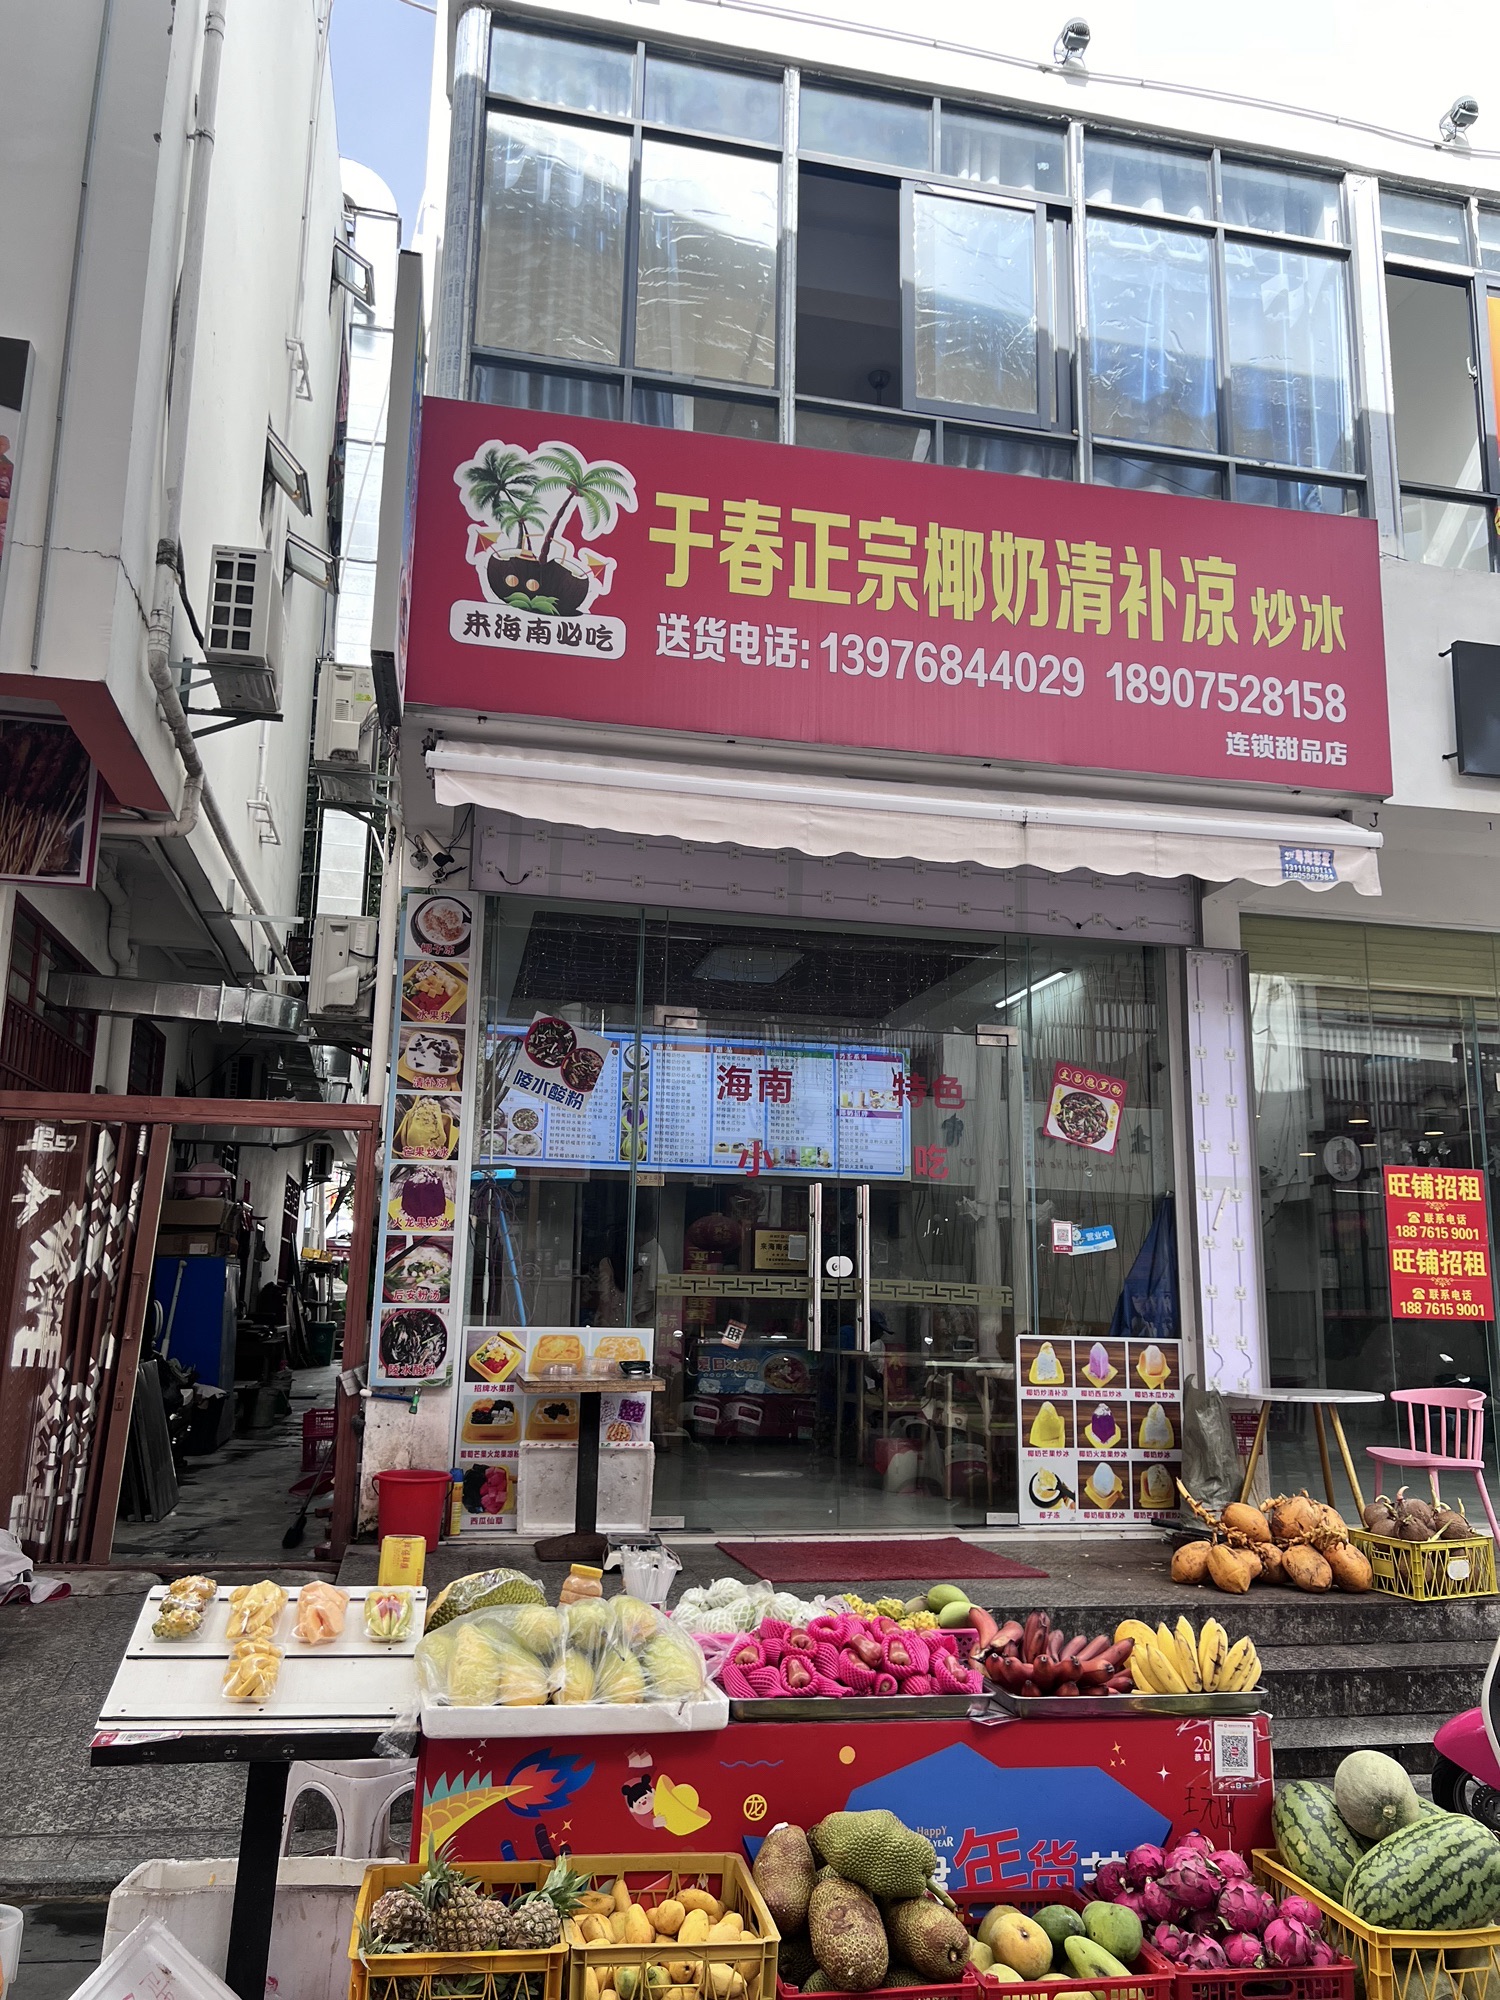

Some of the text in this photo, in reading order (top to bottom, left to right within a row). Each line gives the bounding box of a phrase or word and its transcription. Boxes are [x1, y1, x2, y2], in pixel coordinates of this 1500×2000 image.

[648, 491, 1347, 655] 于春正宗椰奶清补凉 炒冰
[462, 611, 614, 652] 来海南必吃
[817, 631, 1085, 698] 13976844029
[1105, 661, 1347, 723] 18907528158
[1225, 731, 1348, 767] 连锁甜品店
[417, 1010, 451, 1021] 水果捞
[412, 1076, 447, 1088] 清补凉
[717, 1065, 793, 1104] 海南
[891, 1067, 965, 1110] 特色
[513, 1069, 585, 1111] 陵水酸粉
[402, 1146, 449, 1157] 芒果炒冰
[738, 1140, 949, 1179] 小 吃
[1387, 1172, 1482, 1202] 旺铺招租
[393, 1216, 450, 1229] 火龙果炒冰
[1424, 1212, 1467, 1226] 联系电话
[1085, 1229, 1110, 1242] 营业中
[1395, 1225, 1479, 1241] 188 7615 9001
[1392, 1248, 1487, 1277] 旺铺招租
[392, 1289, 440, 1301] 后安粉汤
[1428, 1288, 1472, 1302] 联系电话
[1400, 1301, 1485, 1317] 188 7615 9001
[388, 1363, 436, 1376] 陵水酸粉
[473, 1384, 515, 1393] 招牌水果捞
[1026, 1389, 1068, 1397] 椰奶炒清补凉
[1081, 1390, 1122, 1398] 椰奶西瓜炒冰
[1134, 1391, 1176, 1399] 椰奶木瓜炒冰
[1027, 1450, 1069, 1458] 椰奶芒果炒冰
[1078, 1450, 1128, 1458] 椰奶火龙果炒冰
[1143, 1451, 1171, 1459] 椰奶炒冰
[470, 1516, 503, 1525] 西瓜仙草
[1039, 1511, 1060, 1519] 椰子冻
[1083, 1511, 1125, 1519] 椰奶榴莲炒冰
